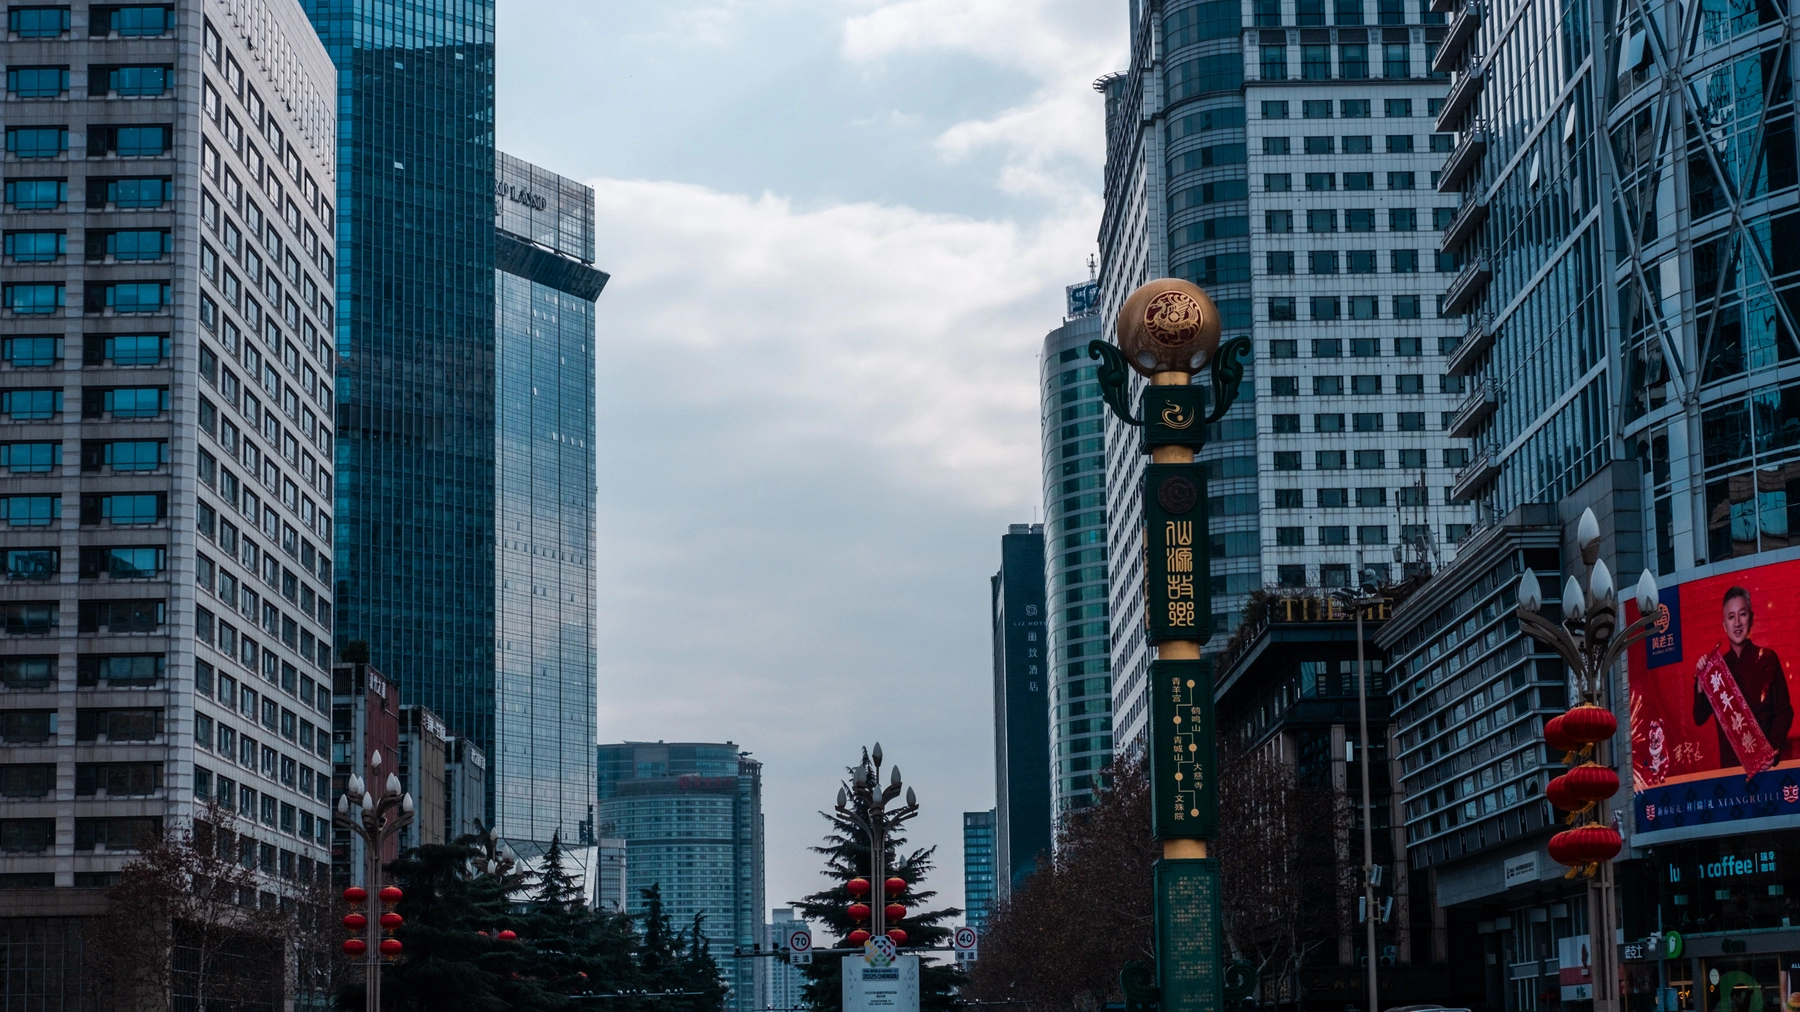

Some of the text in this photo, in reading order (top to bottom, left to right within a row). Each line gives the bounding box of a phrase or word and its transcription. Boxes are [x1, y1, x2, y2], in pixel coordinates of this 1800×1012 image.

[1172, 677, 1181, 702] 青羊宫
[1190, 706, 1201, 732] 鹤鸣山
[1173, 736, 1184, 762] 青城山
[1194, 762, 1204, 790] 大慈寺
[1174, 794, 1184, 820] 文殊院
[1670, 855, 1752, 882] lun coffee
[794, 938, 807, 946] 70
[959, 934, 972, 943] 40
[792, 954, 810, 964] 主道
